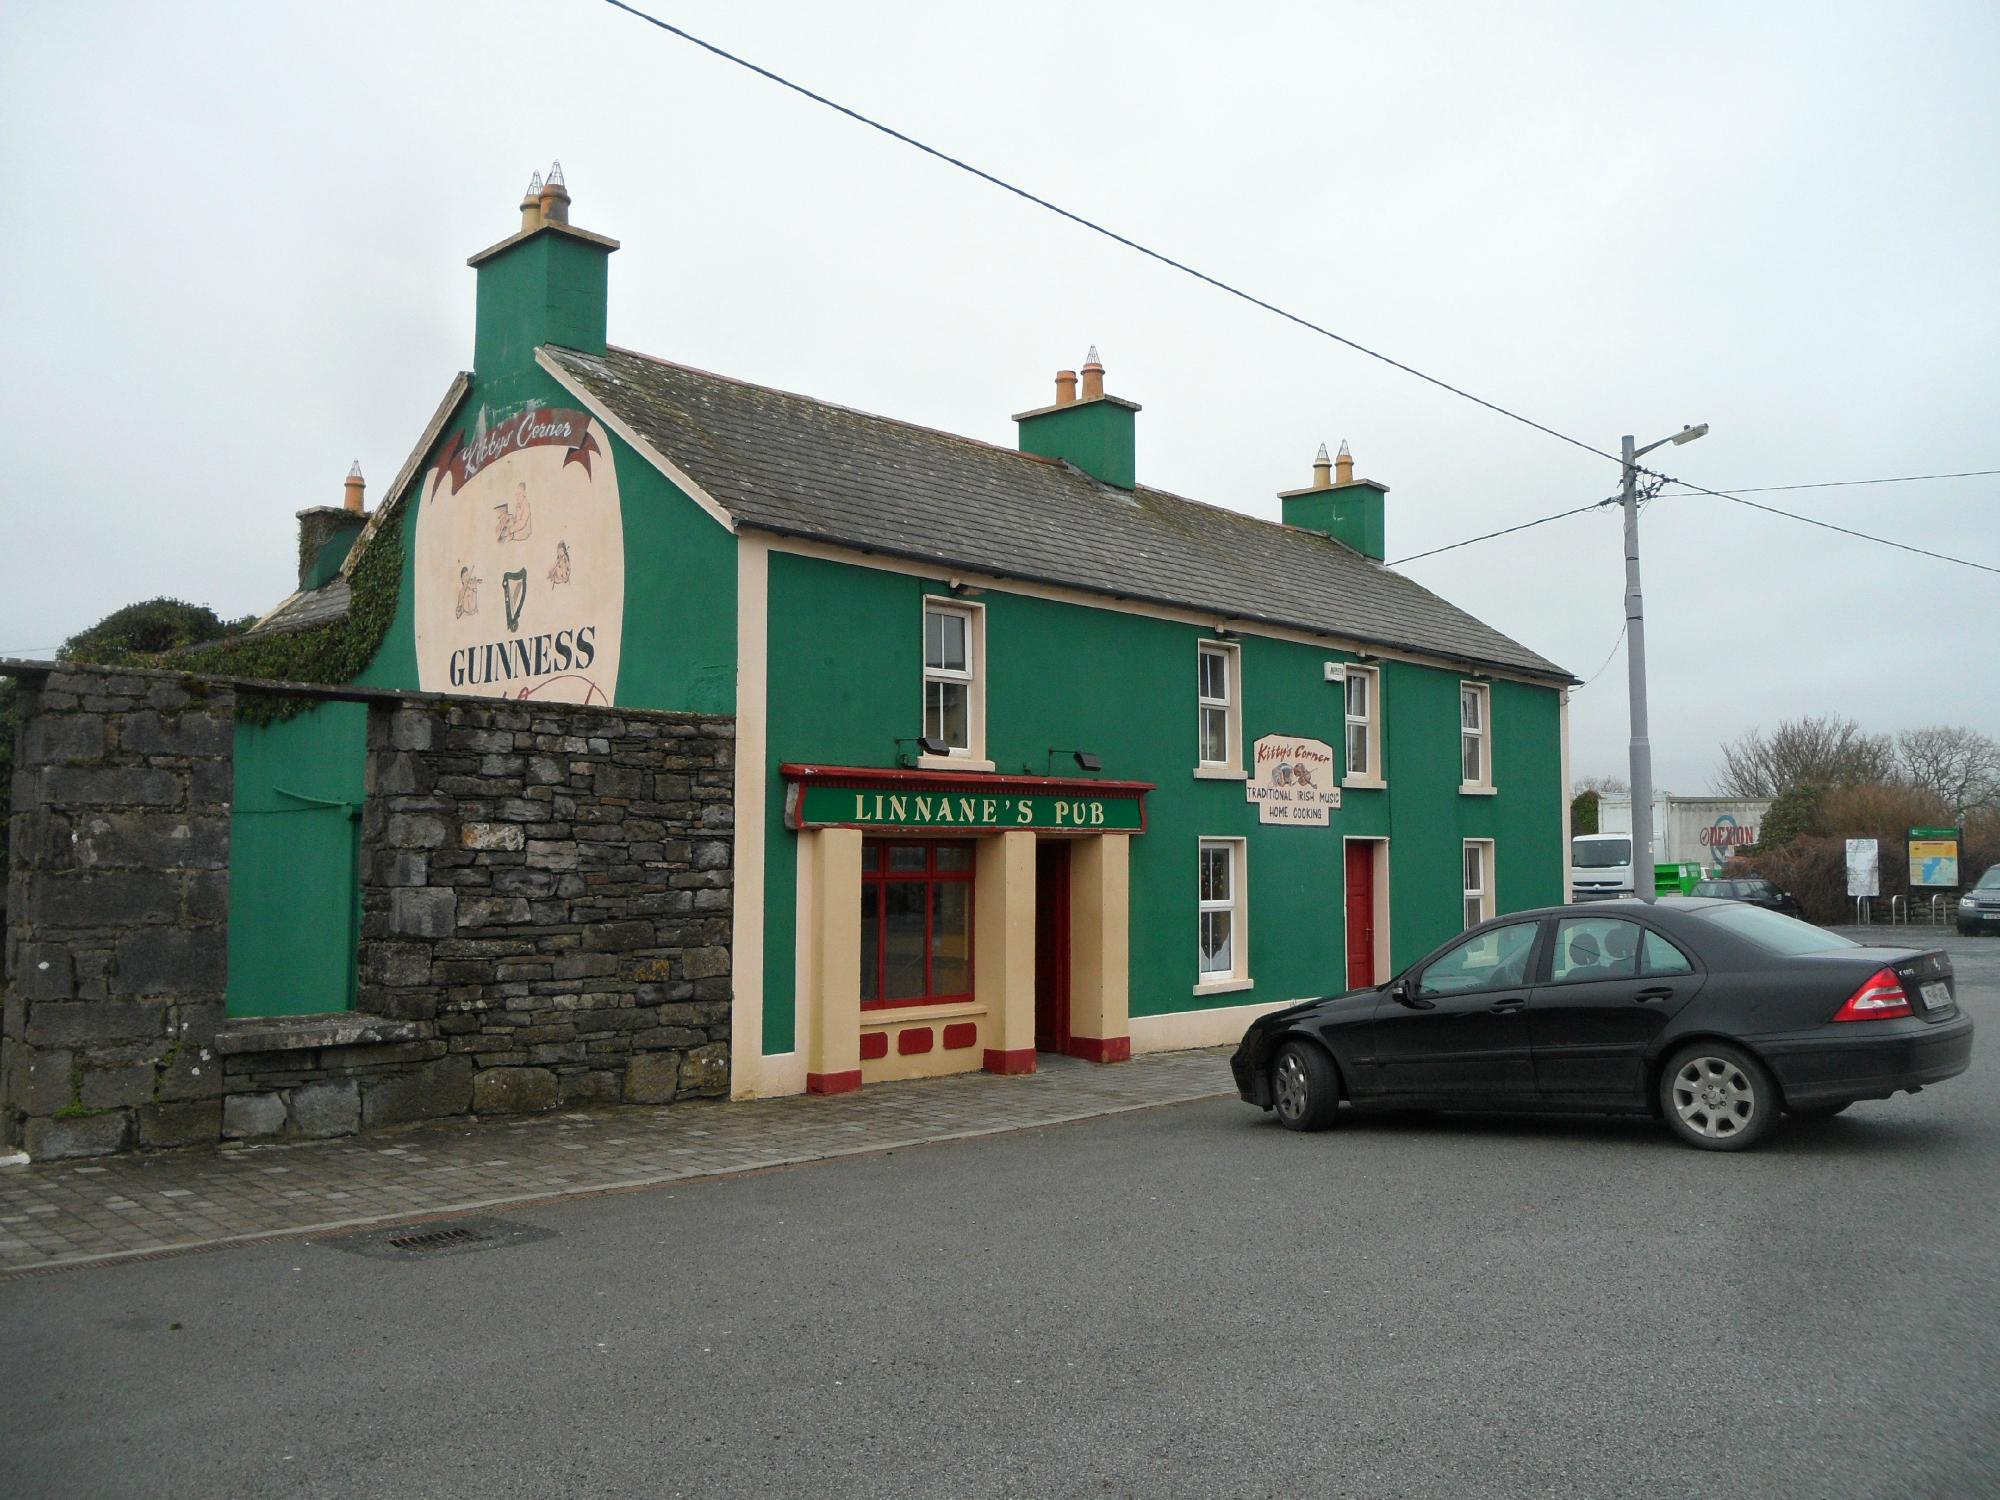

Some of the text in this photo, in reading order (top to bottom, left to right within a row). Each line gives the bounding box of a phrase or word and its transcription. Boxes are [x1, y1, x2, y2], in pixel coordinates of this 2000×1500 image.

[516, 411, 572, 447] Corner
[449, 626, 596, 686] GUINNESS
[1257, 742, 1331, 764] Kitty's Corner
[1247, 787, 1339, 804] TRADITIONAL IRISH MUSIC
[855, 794, 1105, 824] LINNANE'S PUB
[1269, 806, 1322, 819] HOME COOKING
[1710, 826, 1754, 846] DEXION
